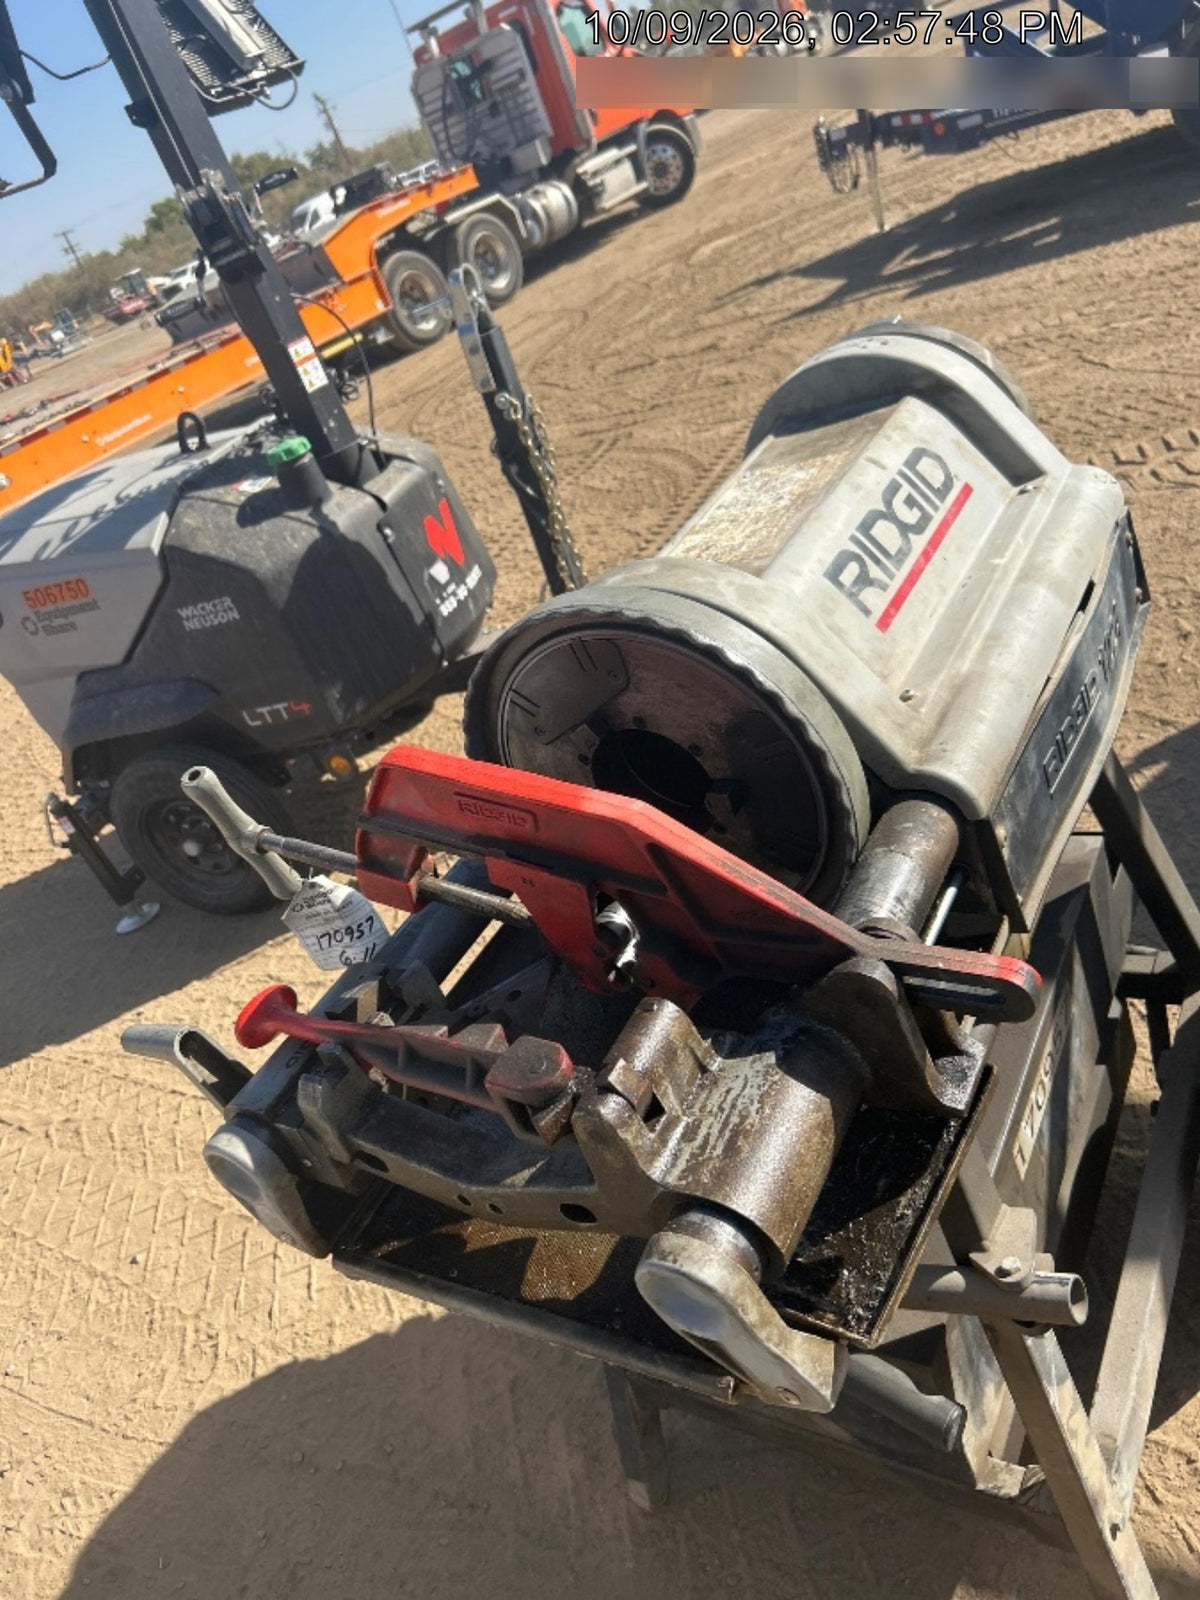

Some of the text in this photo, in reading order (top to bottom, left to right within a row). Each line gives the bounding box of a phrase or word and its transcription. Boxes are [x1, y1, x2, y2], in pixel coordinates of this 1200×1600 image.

[823, 447, 954, 618] RIDGID
[23, 578, 90, 609] 506750
[177, 596, 235, 619] WACKER
[182, 608, 240, 631] NEUSON
[242, 701, 311, 727] LTT4
[316, 914, 375, 951] 170957
